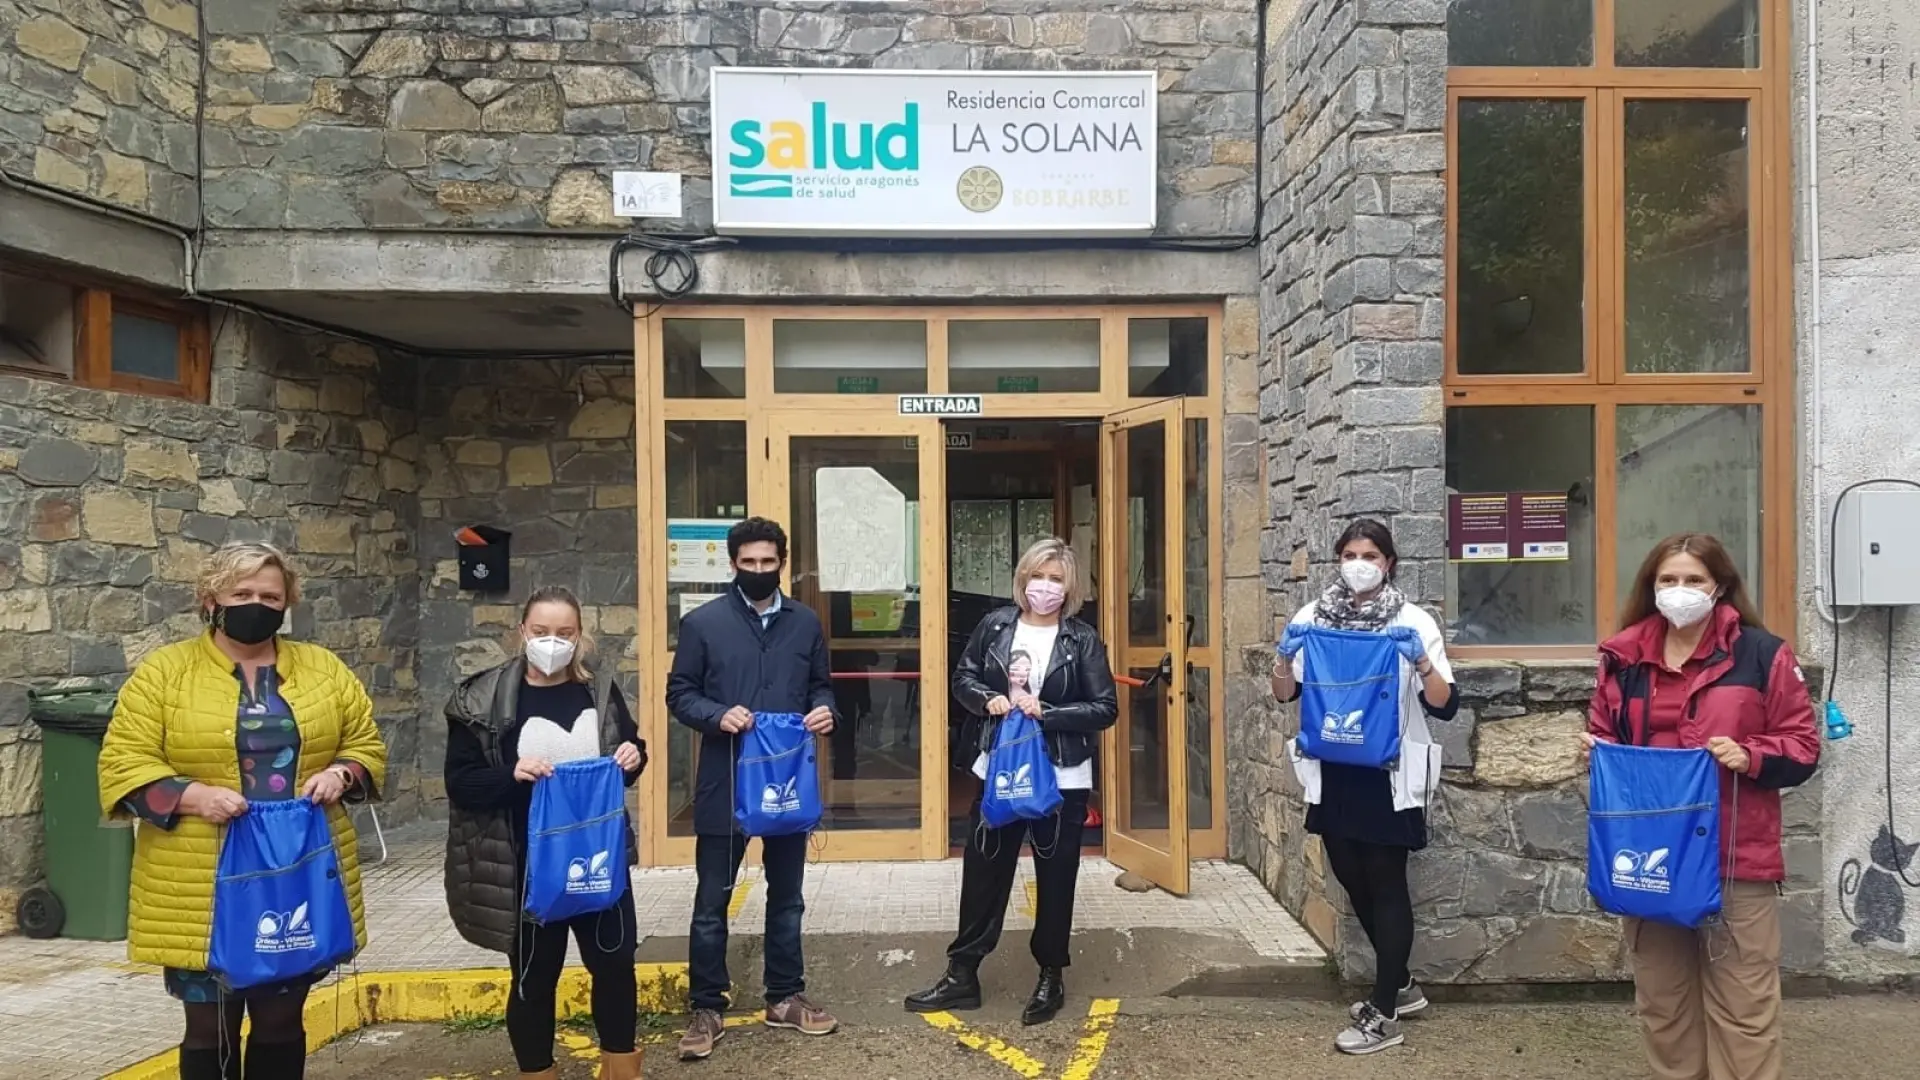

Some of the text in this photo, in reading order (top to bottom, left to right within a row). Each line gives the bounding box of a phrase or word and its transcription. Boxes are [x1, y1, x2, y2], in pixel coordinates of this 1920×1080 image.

[947, 89, 1145, 109] Residencia Comarcal
[728, 101, 920, 171] salud
[952, 122, 1143, 153] LA SOLANA
[796, 174, 920, 189] servicio aragonés
[796, 187, 857, 199] de salud
[1012, 188, 1131, 210] SOBRARBE
[902, 398, 978, 412] ENTRADA
